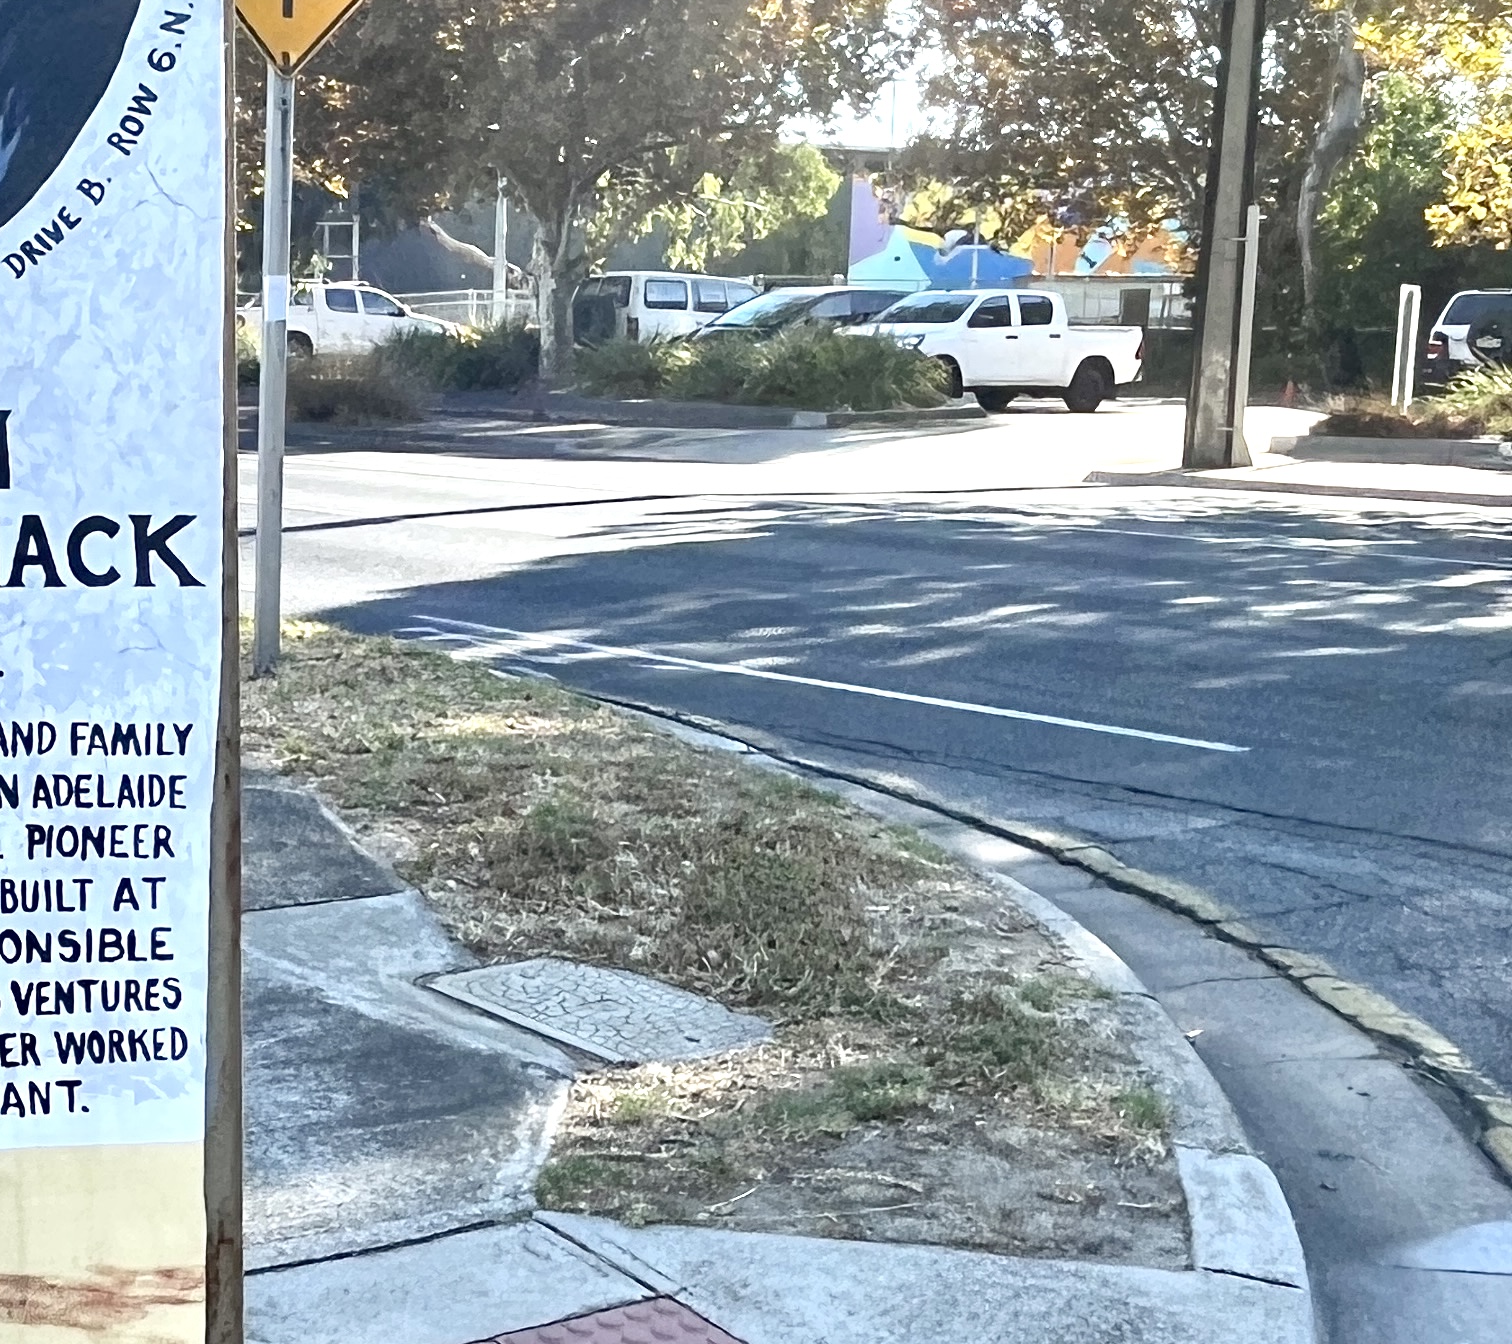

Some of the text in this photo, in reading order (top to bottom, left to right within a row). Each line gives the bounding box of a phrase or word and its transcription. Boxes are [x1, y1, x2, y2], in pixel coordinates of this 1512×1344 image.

[0, 204, 83, 280] DRIVE
[75, 175, 114, 207] B.
[105, 81, 159, 157] ROW
[69, 720, 195, 758] FAMILY
[31, 773, 188, 811] ADELAIDE
[25, 823, 176, 861] PIONEER
[0, 877, 94, 915] BUILT
[111, 875, 168, 913] AT
[9, 976, 183, 1018] VENTURES
[53, 1025, 189, 1066] WORKED
